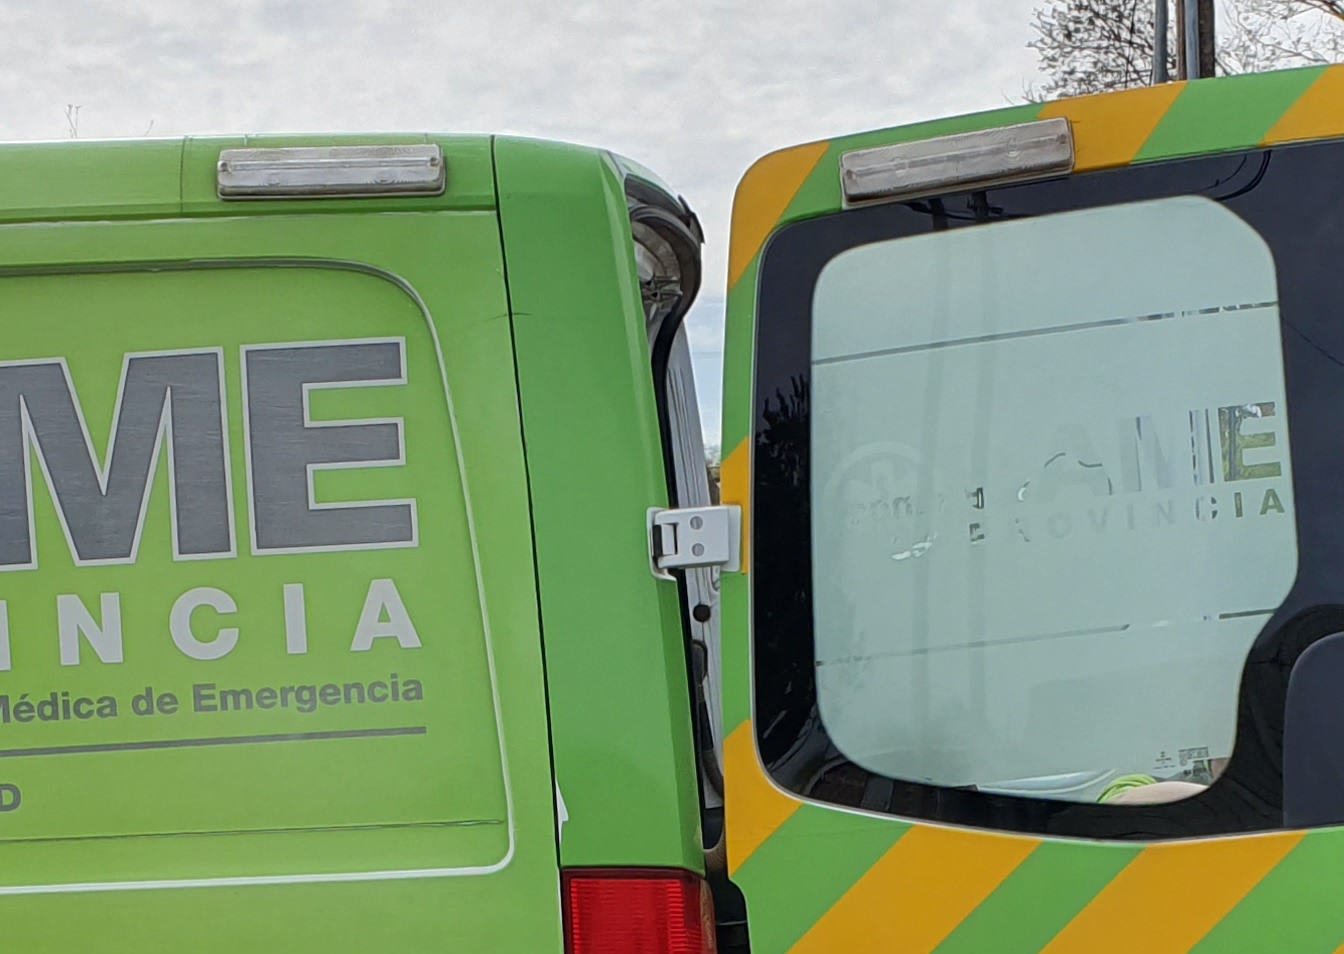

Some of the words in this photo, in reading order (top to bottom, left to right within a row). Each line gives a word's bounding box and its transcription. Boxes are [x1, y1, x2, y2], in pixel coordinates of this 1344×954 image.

[964, 402, 1282, 510] AME
[131, 687, 179, 716] de
[192, 673, 424, 713] Emergencia
